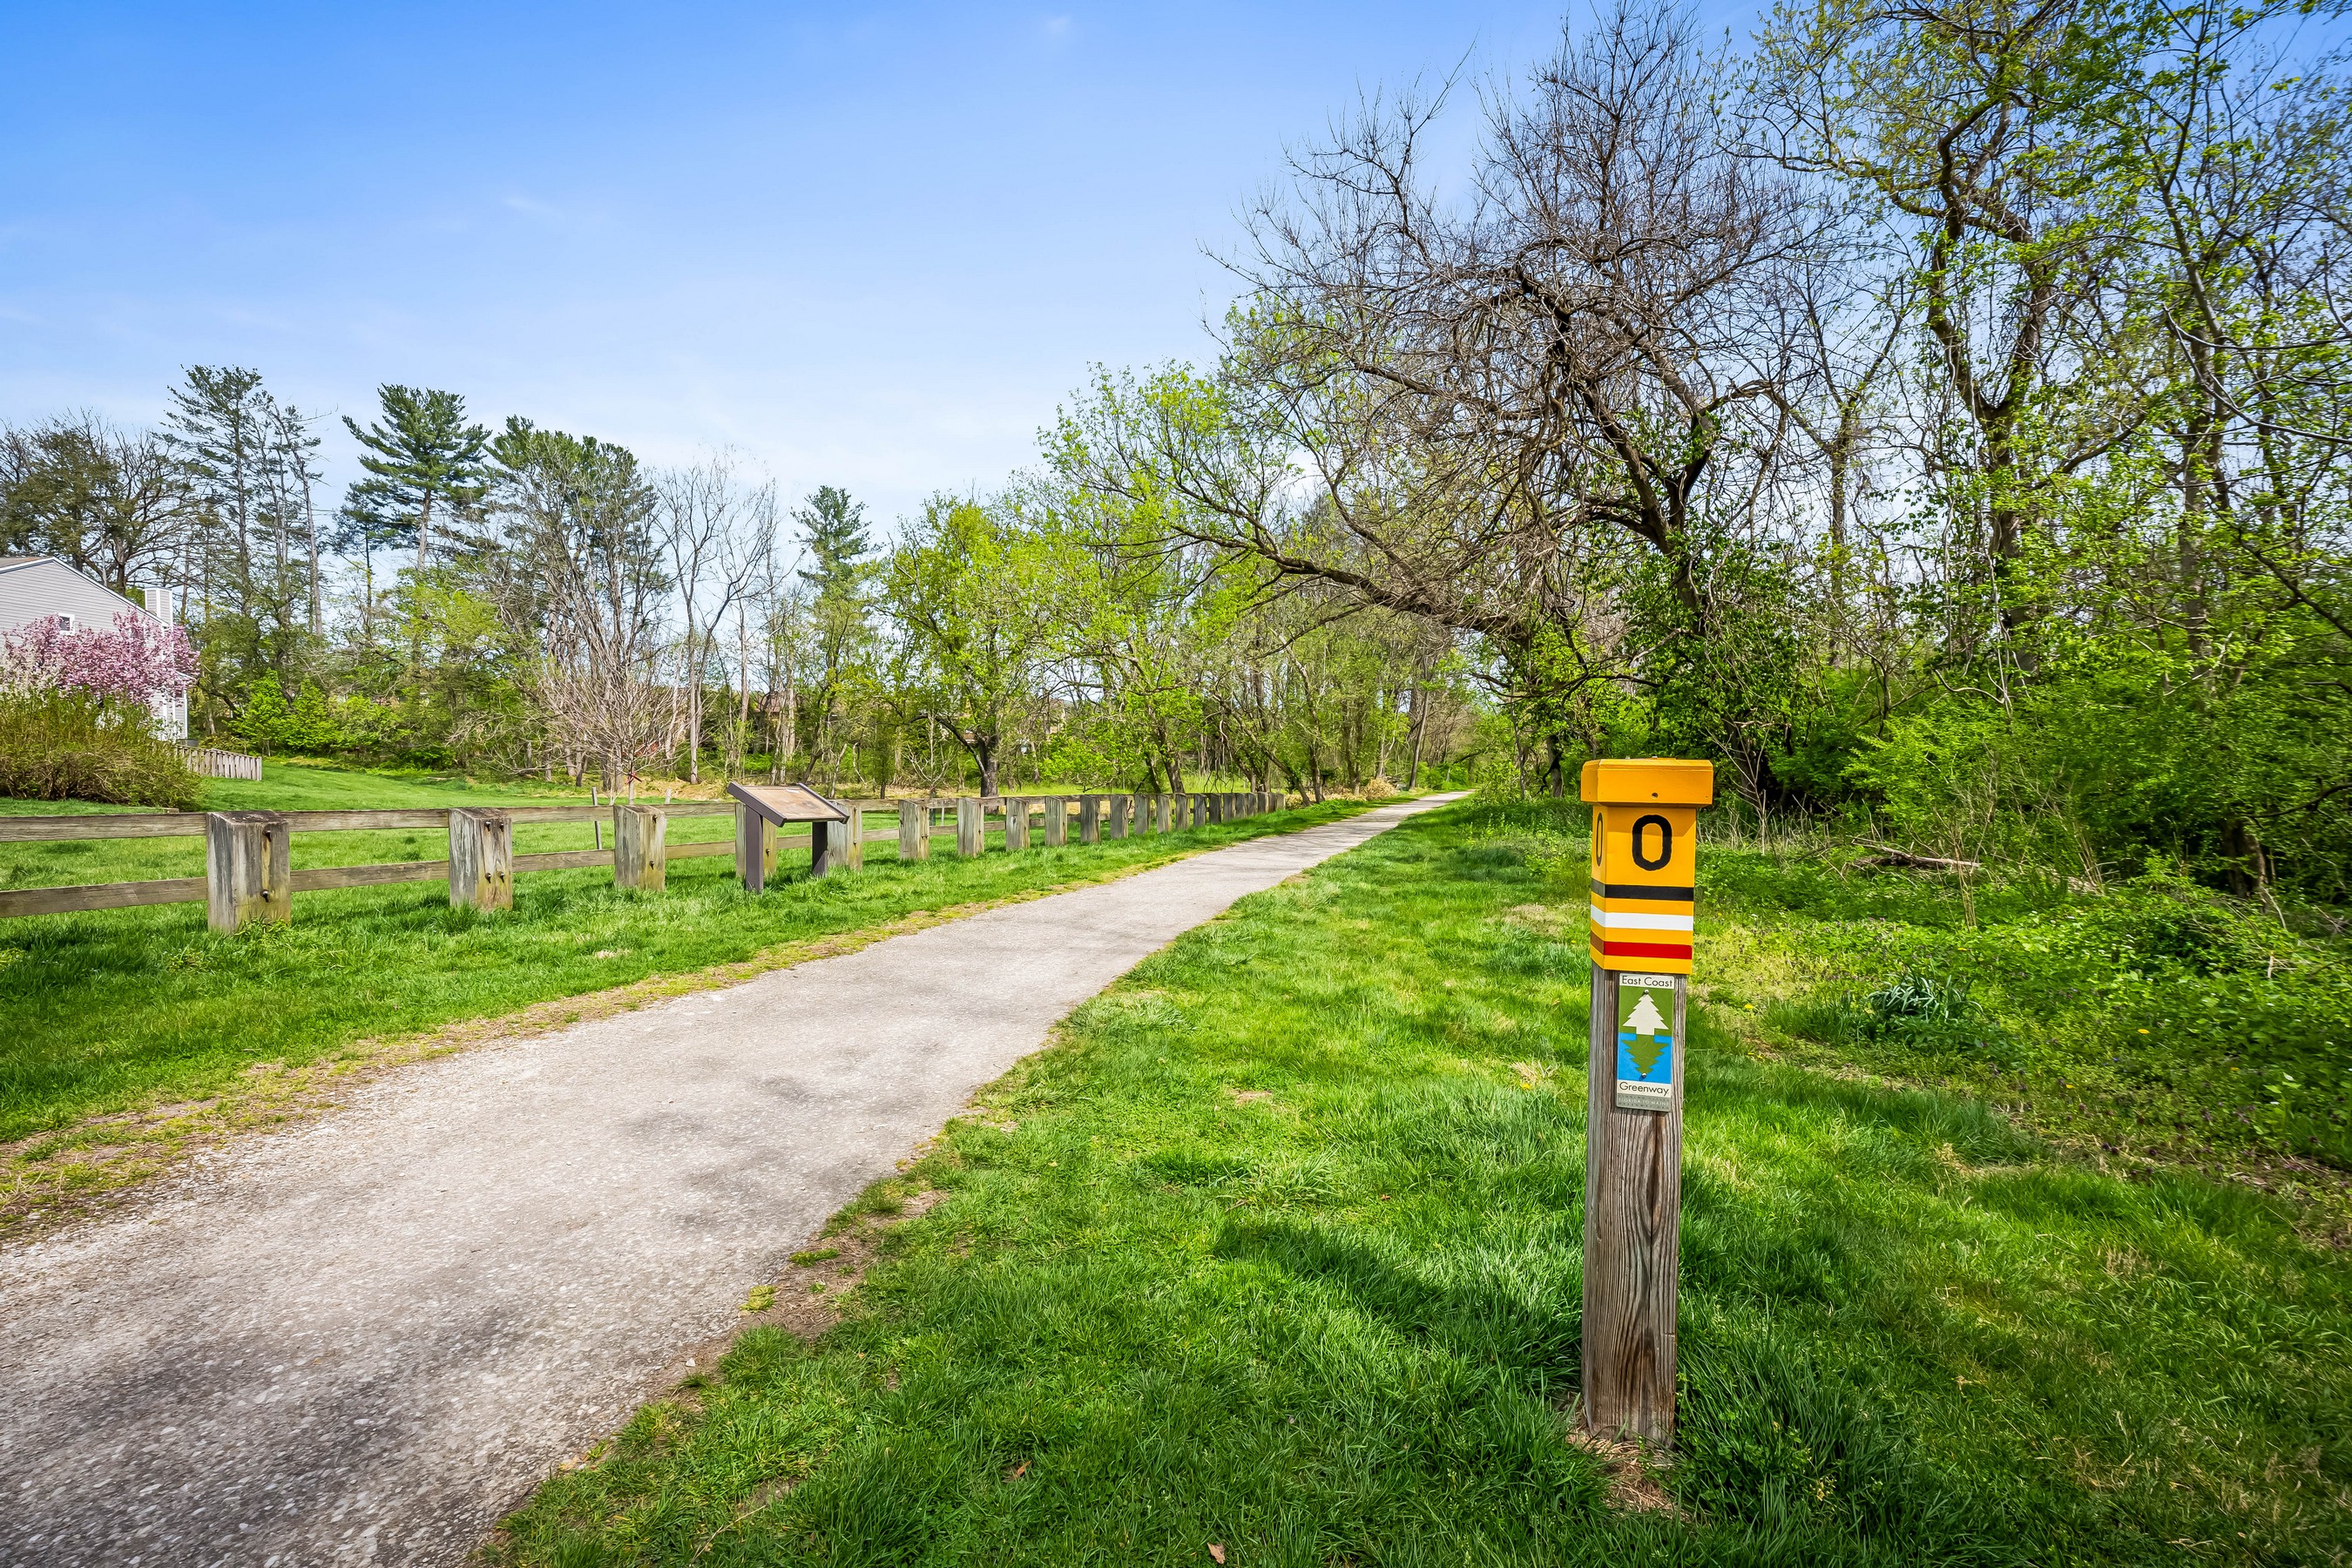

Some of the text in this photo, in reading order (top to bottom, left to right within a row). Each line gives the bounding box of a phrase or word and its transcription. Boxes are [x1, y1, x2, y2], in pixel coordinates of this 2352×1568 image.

[1596, 813, 1603, 867] 0
[1632, 814, 1673, 871] 0
[1622, 976, 1673, 987] East Coast
[1619, 1082, 1669, 1096] Greenway
